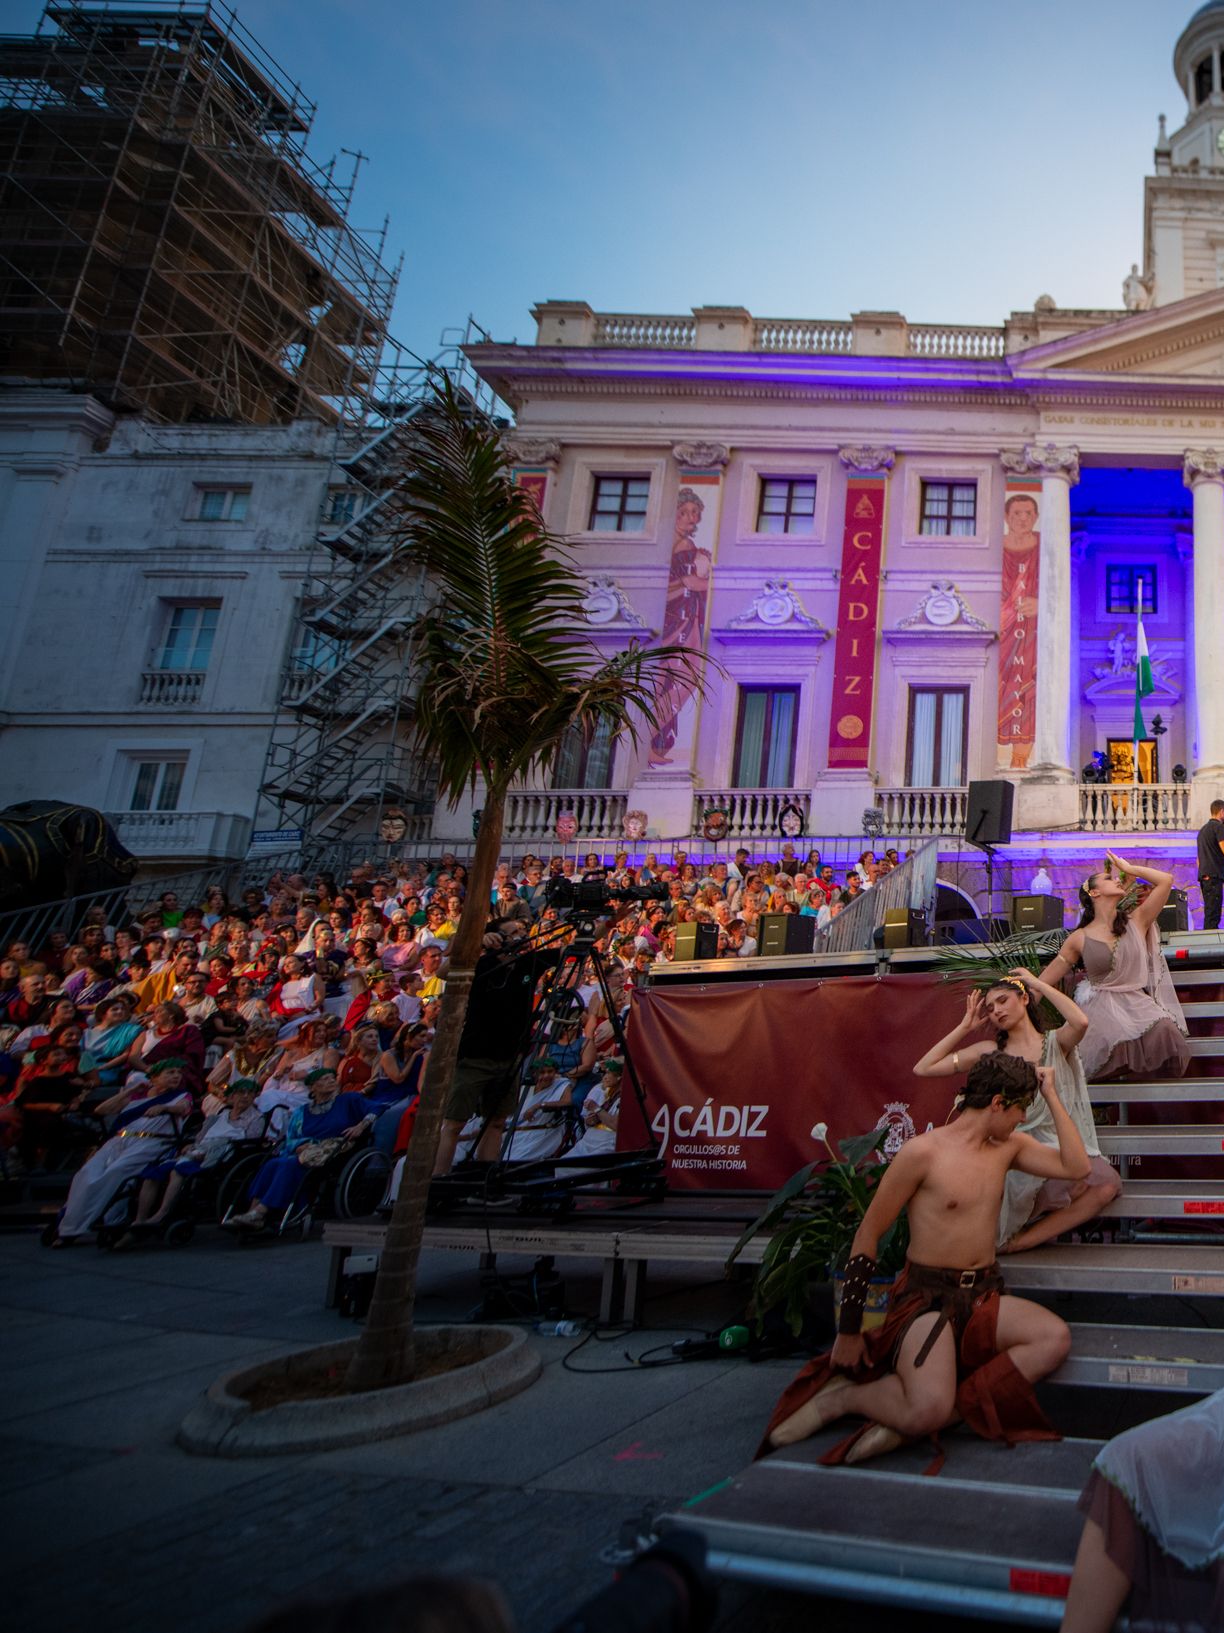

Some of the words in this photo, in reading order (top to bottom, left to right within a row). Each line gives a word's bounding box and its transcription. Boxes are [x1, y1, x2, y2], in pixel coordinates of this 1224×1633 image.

[844, 532, 872, 694] CÁDIZ
[1014, 563, 1026, 639] BALBO
[1012, 656, 1025, 734] MAYOR
[671, 1159, 708, 1169] NUESTRA
[709, 1160, 747, 1170] HISTORIA
[674, 1144, 726, 1155] ORGULLOS@S
[727, 1145, 740, 1155] DE
